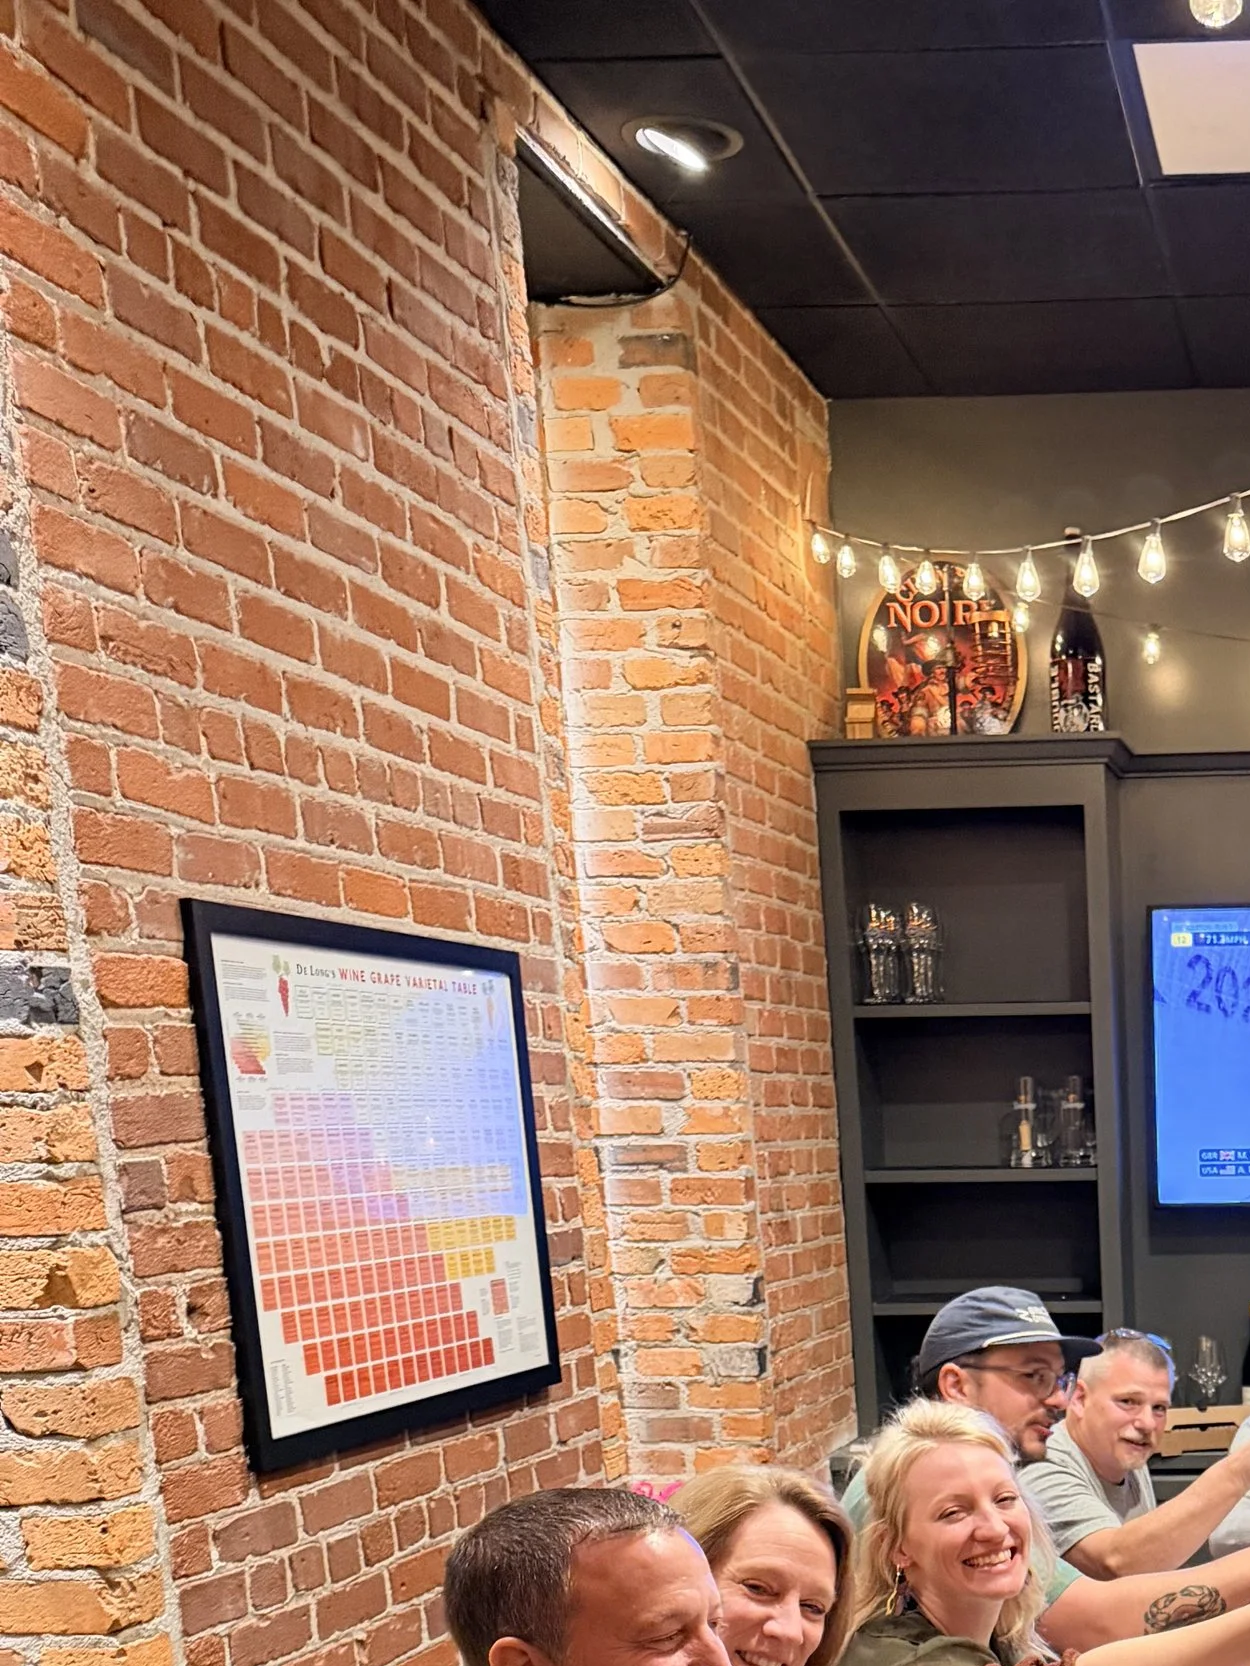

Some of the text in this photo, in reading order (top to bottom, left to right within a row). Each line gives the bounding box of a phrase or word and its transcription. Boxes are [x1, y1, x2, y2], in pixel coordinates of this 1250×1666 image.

[338, 967, 366, 983] WINE
[370, 971, 402, 987] GRAPE
[405, 976, 448, 992] VARIETAL
[451, 981, 477, 995] TABLE
[1201, 1151, 1218, 1160] GBR
[1201, 1166, 1218, 1175] USA
